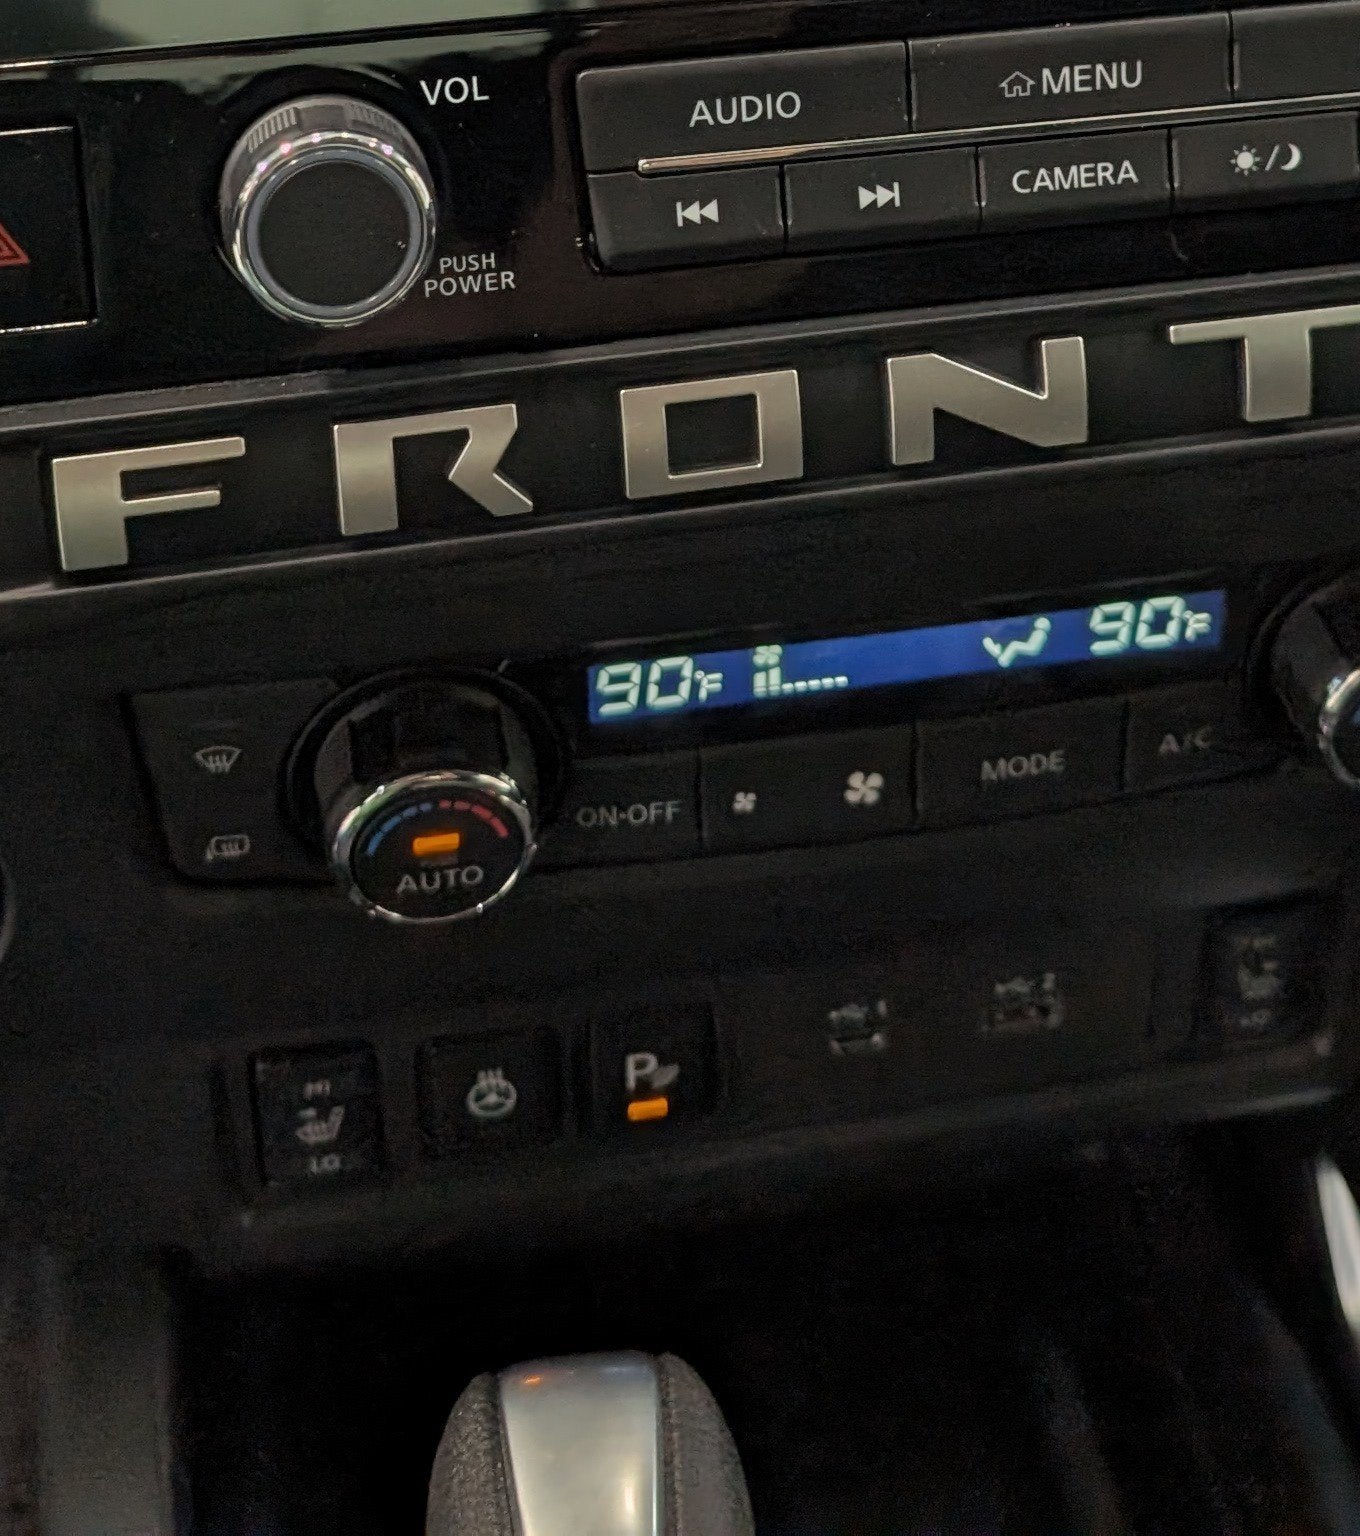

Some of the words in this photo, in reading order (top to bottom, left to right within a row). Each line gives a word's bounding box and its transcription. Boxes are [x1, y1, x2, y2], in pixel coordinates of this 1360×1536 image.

[420, 75, 490, 106] VOL
[1040, 60, 1144, 96] MENU
[689, 91, 802, 128] AUDIO
[1011, 159, 1139, 195] CAMERA
[438, 252, 497, 275] PUSH
[424, 269, 517, 298] POWER
[1158, 726, 1214, 756] A/C
[980, 748, 1066, 782] MODE
[396, 865, 485, 896] AUTO
